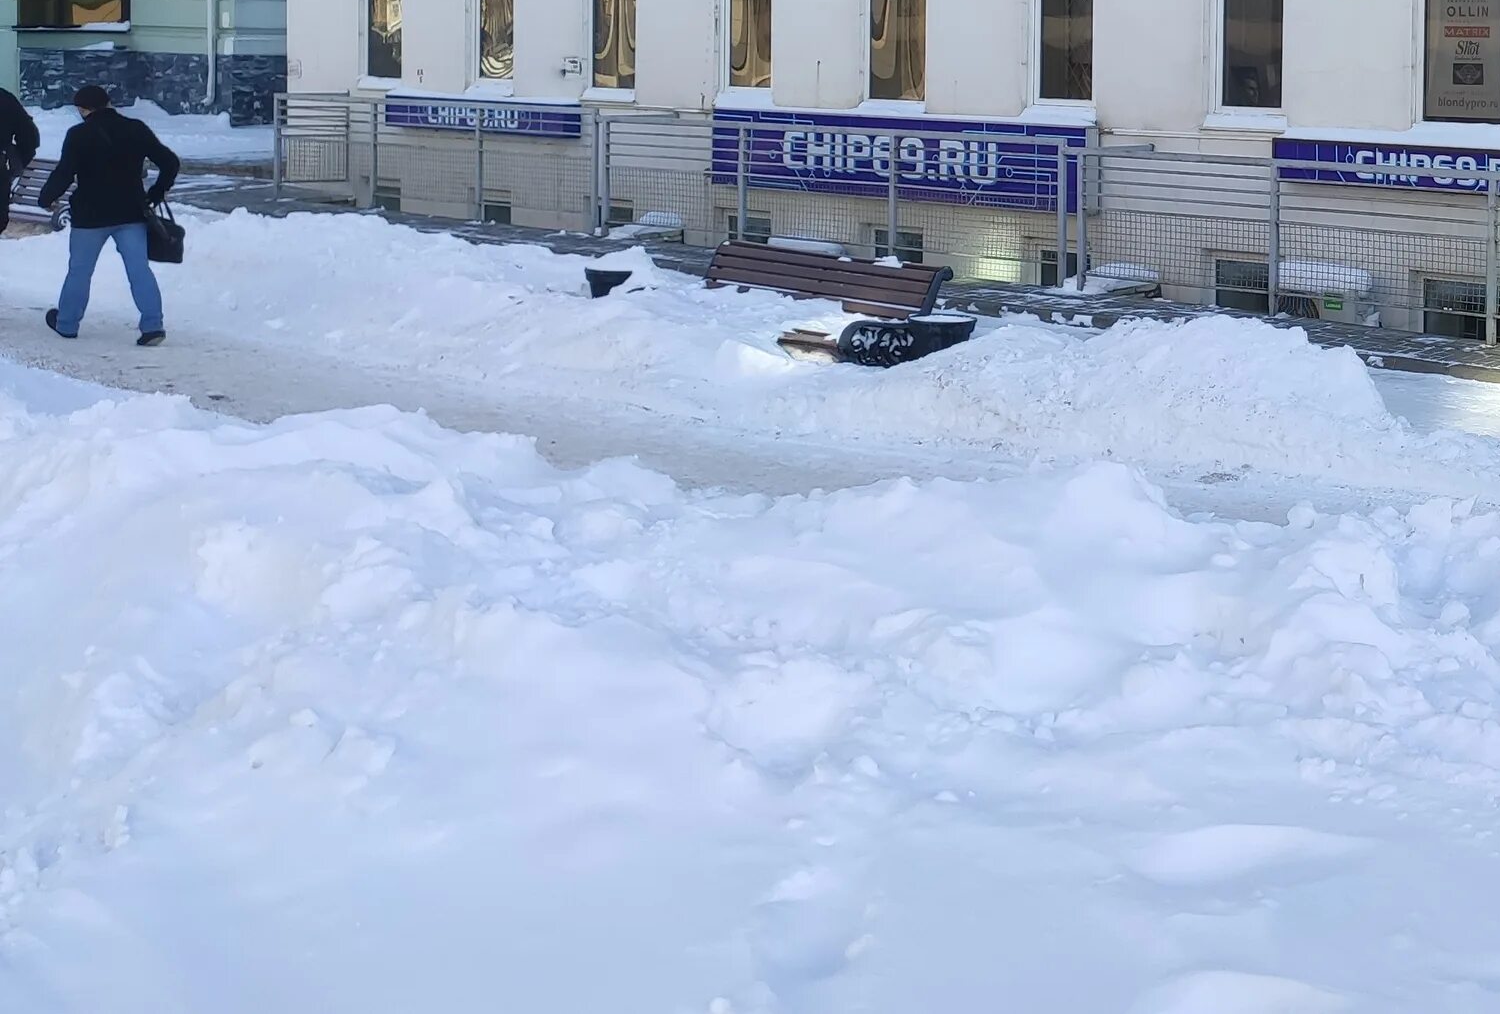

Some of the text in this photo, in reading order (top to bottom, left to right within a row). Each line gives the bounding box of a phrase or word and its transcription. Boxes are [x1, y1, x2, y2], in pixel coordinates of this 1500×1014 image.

[1446, 6, 1489, 18] OLLIN
[1445, 27, 1489, 37] MATRIX
[1437, 97, 1499, 111] blondypro.ru
[782, 130, 1000, 185] CHIP69.RU
